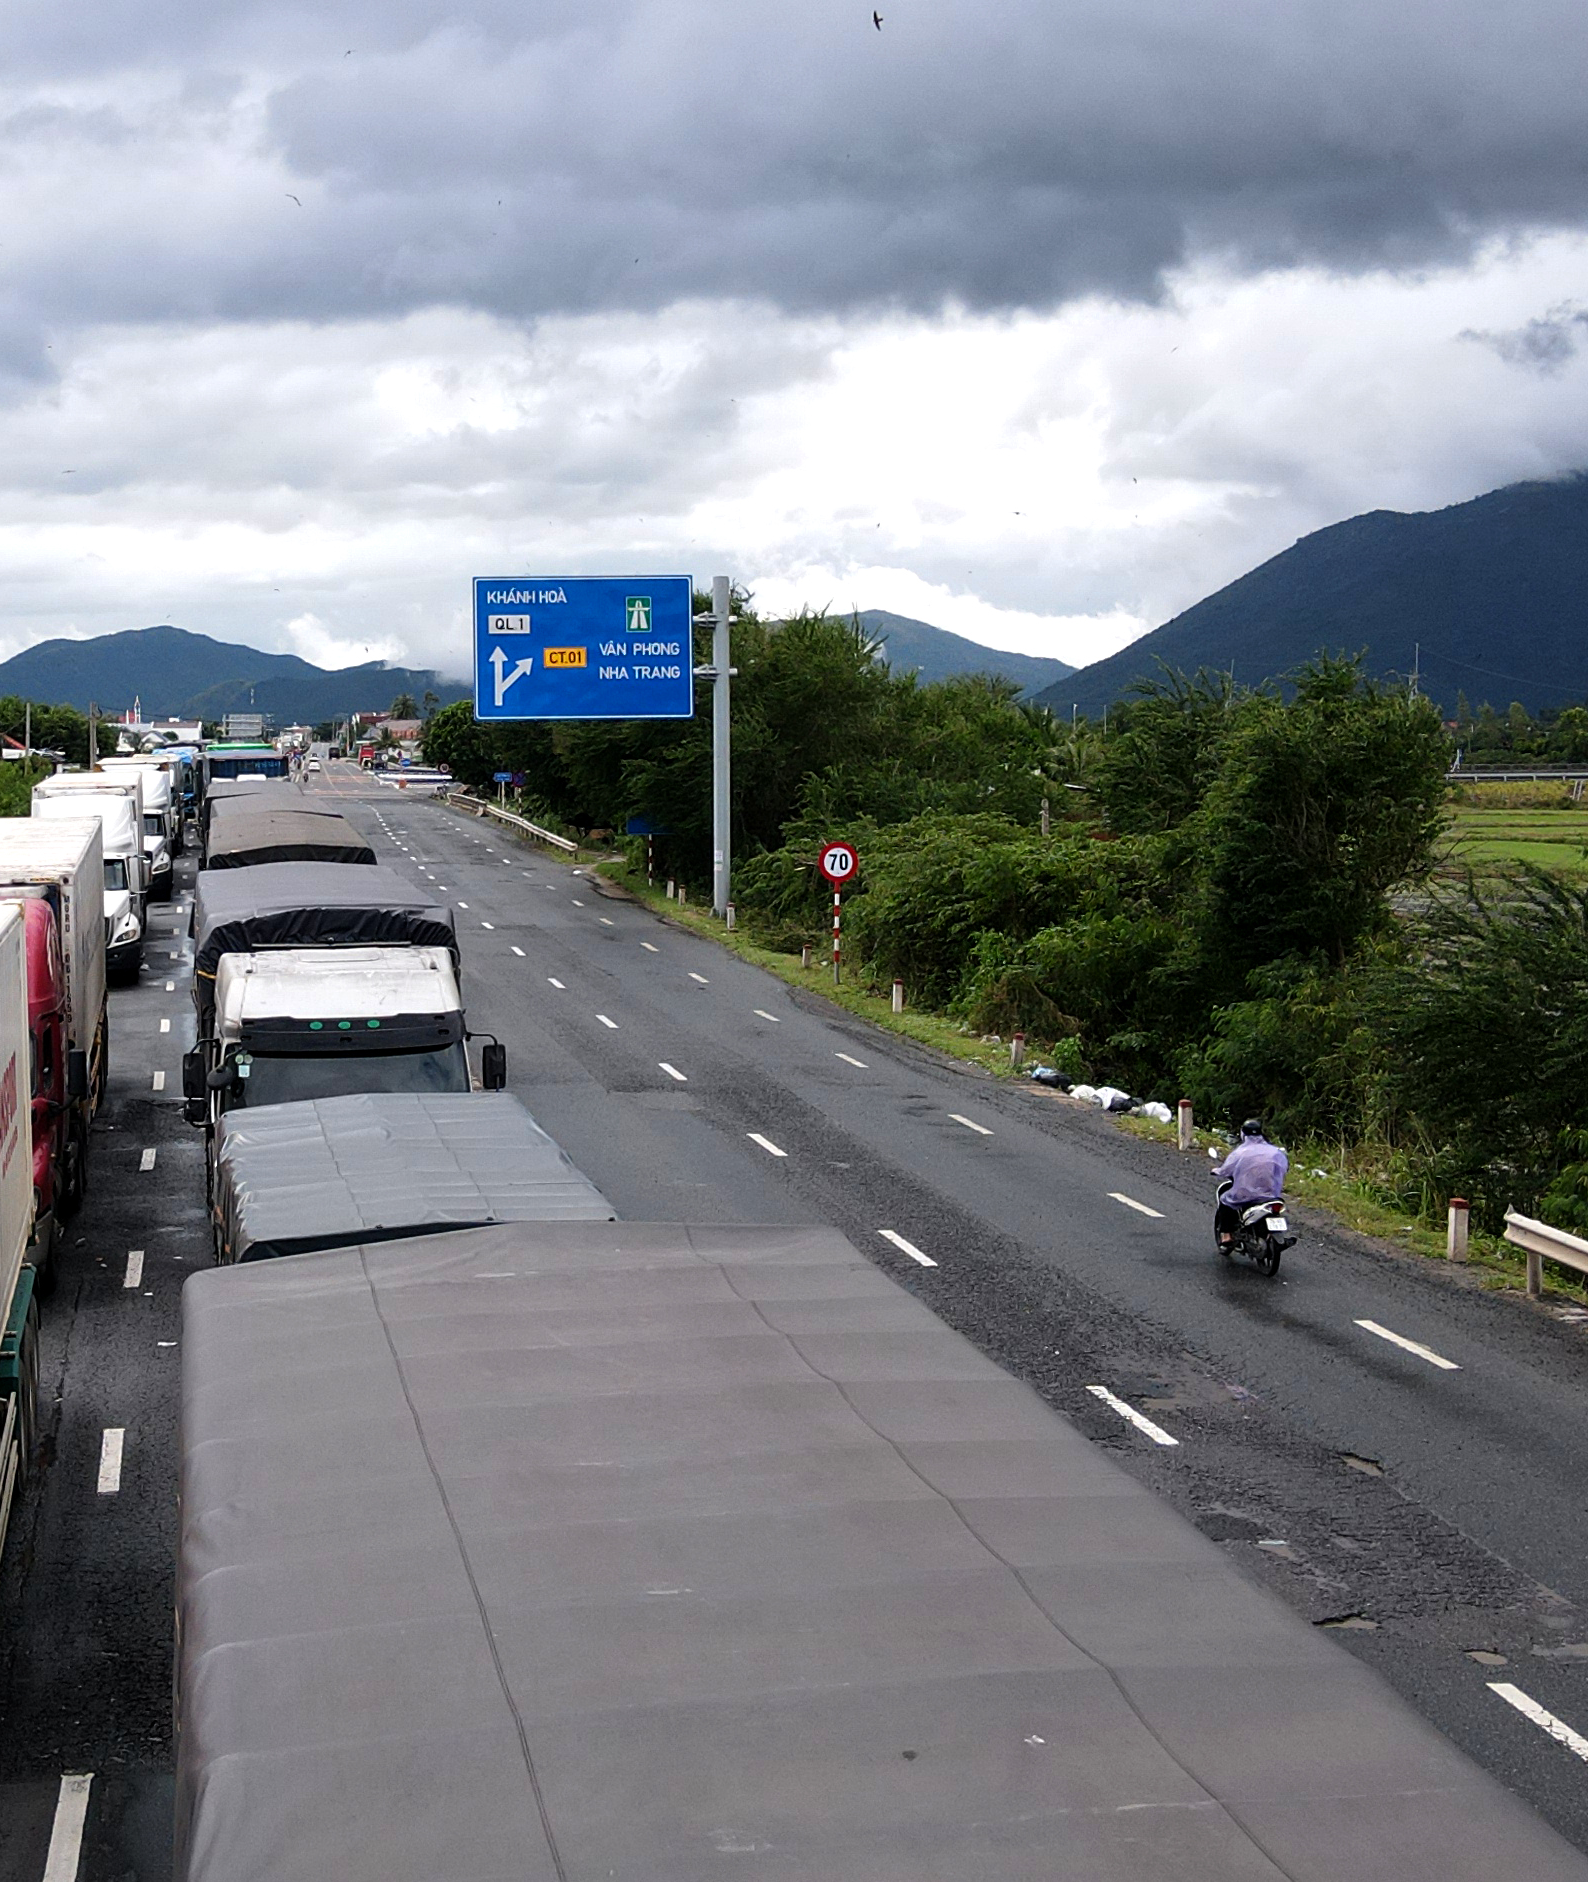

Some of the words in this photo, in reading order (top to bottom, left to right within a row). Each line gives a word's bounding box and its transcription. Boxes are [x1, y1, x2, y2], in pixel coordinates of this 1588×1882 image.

[486, 587, 536, 604] KHÁNH
[539, 587, 568, 604] HOÀ
[599, 641, 627, 656] VÂN
[633, 642, 680, 656] PHONG
[549, 650, 582, 664] CT.01
[599, 666, 628, 680] NHA
[632, 665, 680, 679] TRANG
[828, 853, 849, 871] 70
